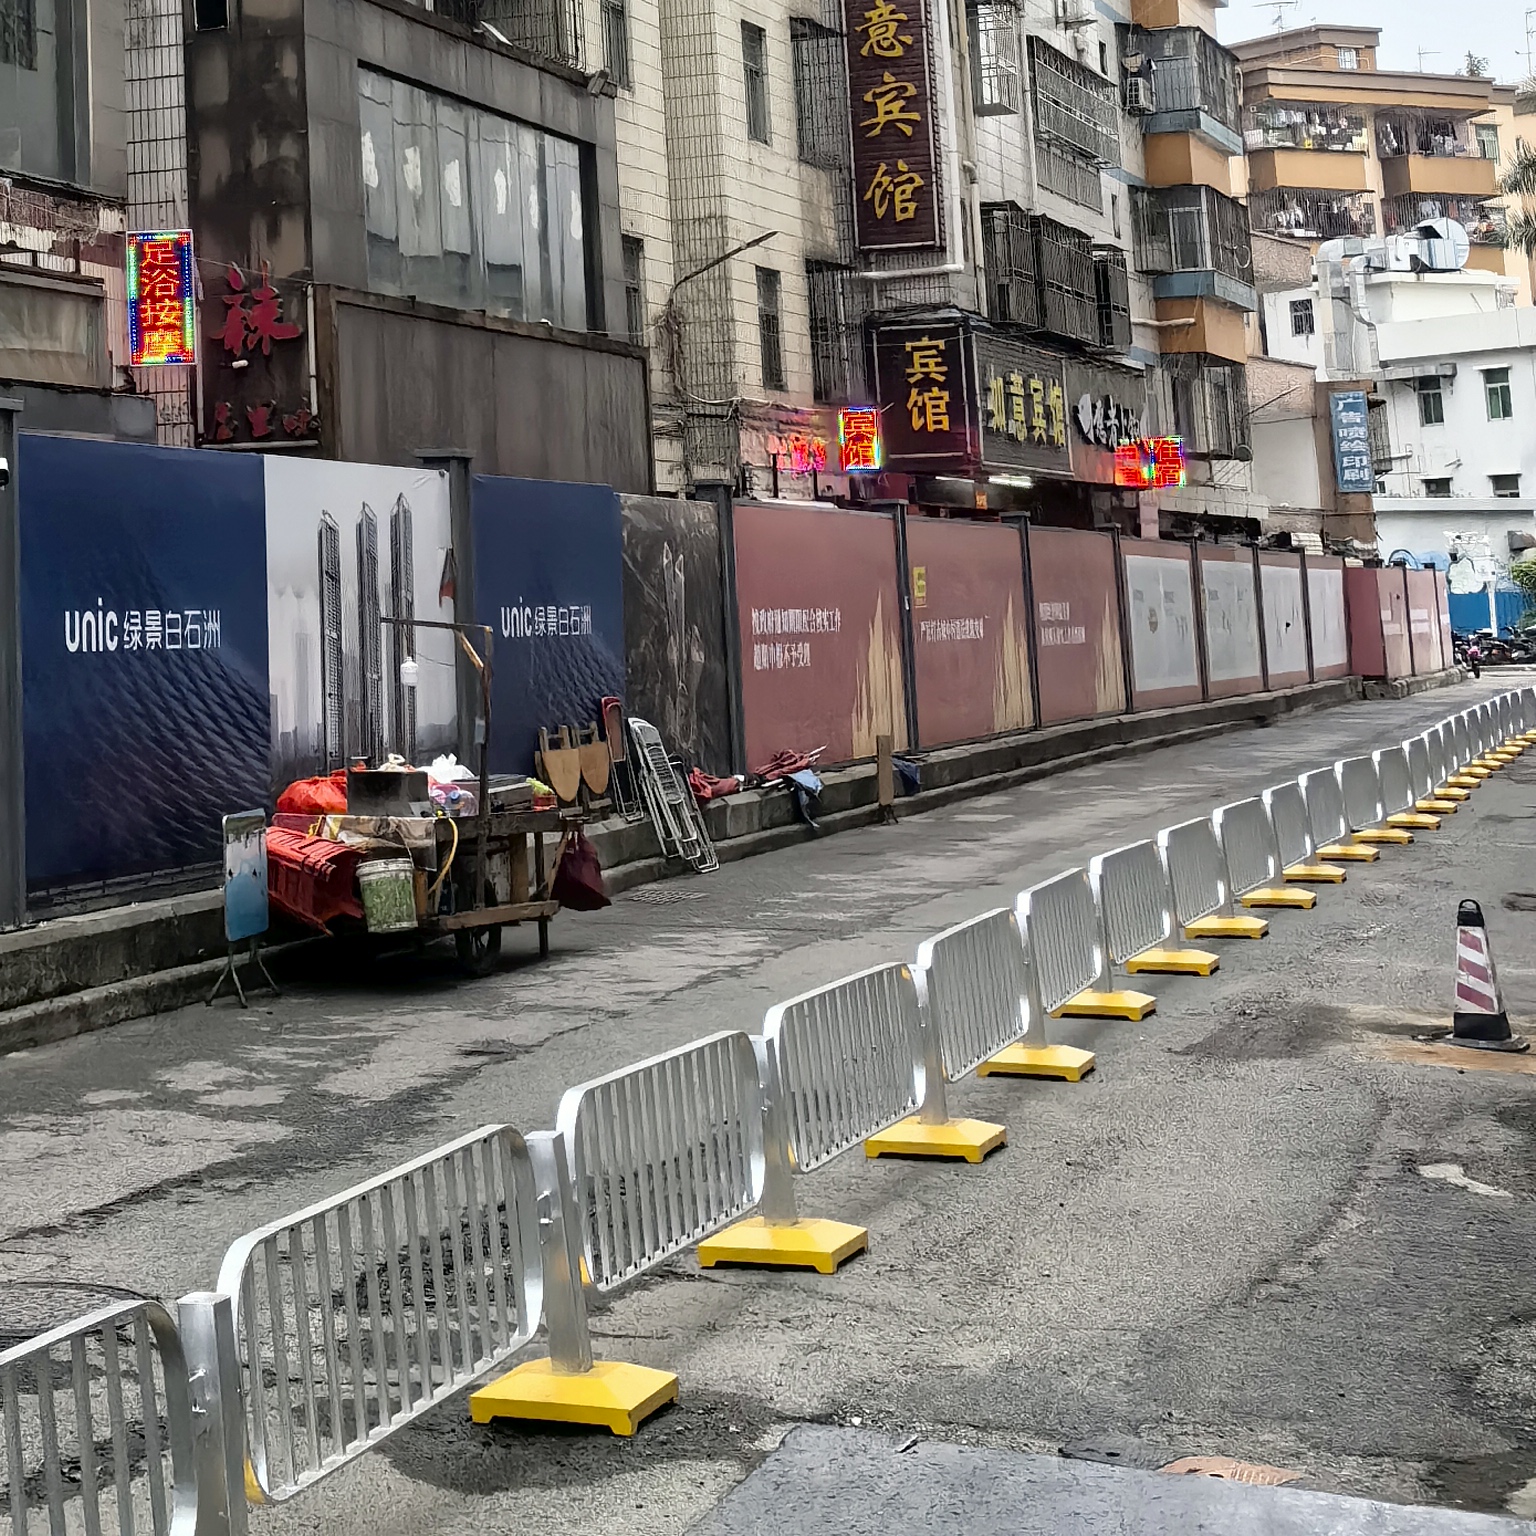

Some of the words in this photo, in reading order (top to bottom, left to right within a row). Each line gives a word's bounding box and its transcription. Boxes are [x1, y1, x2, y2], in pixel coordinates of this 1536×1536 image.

[140, 239, 185, 357] 足浴按摩
[905, 335, 951, 433] 宾馆
[986, 363, 1066, 448] 如意宾馆
[844, 411, 876, 468] 宾馆
[64, 596, 119, 653] unic
[123, 609, 221, 651] 绿景白石洲
[500, 595, 532, 638] unic
[534, 605, 592, 637] 绿景白石洲
